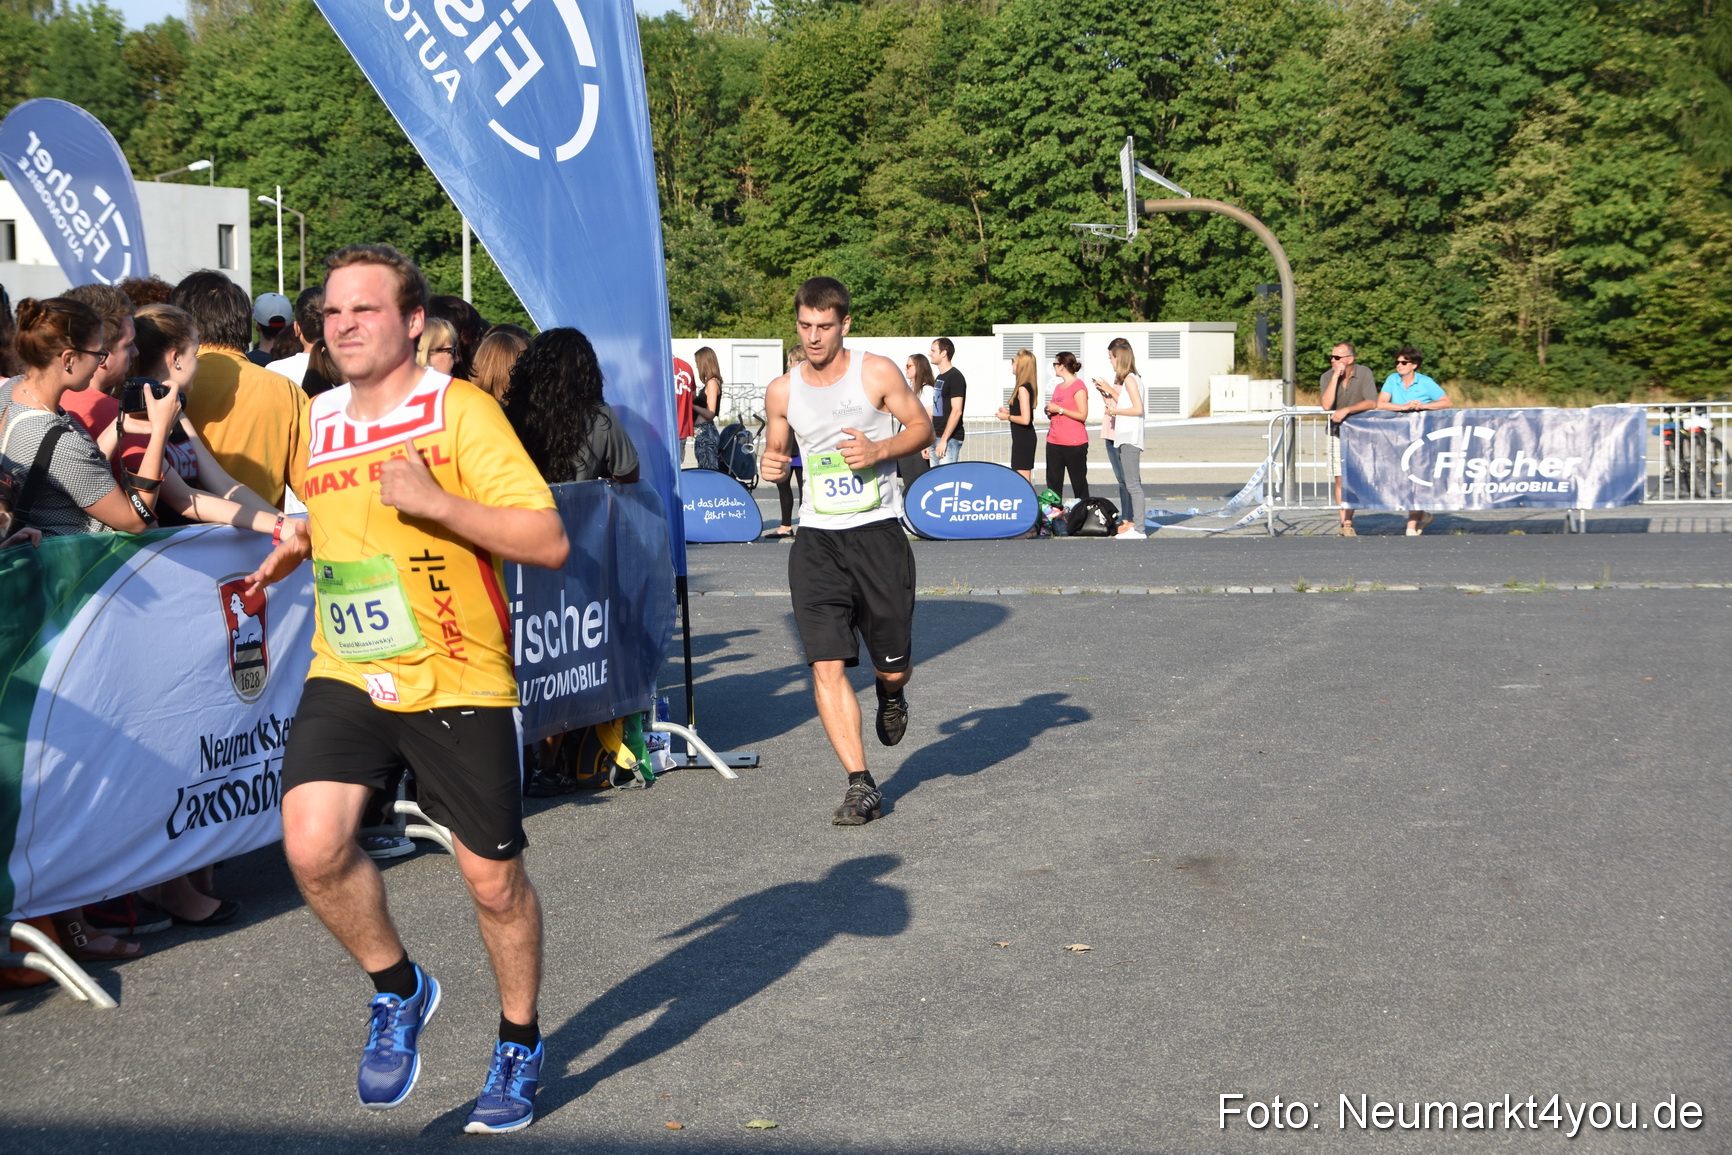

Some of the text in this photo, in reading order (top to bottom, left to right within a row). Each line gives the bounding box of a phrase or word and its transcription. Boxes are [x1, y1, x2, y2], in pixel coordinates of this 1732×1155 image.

[1433, 450, 1583, 479] Fischer
[304, 467, 360, 500] MAX
[824, 475, 864, 497] 350
[1447, 481, 1569, 494] AUTOMOBILE
[131, 494, 150, 518] SONY
[697, 497, 713, 508] das
[941, 495, 1022, 513] Fischer
[704, 510, 746, 524] fährt mit!
[949, 513, 1018, 522] AUTOMOBILE
[330, 599, 390, 635] 915
[509, 589, 610, 666] ischer
[241, 671, 261, 691] 1628
